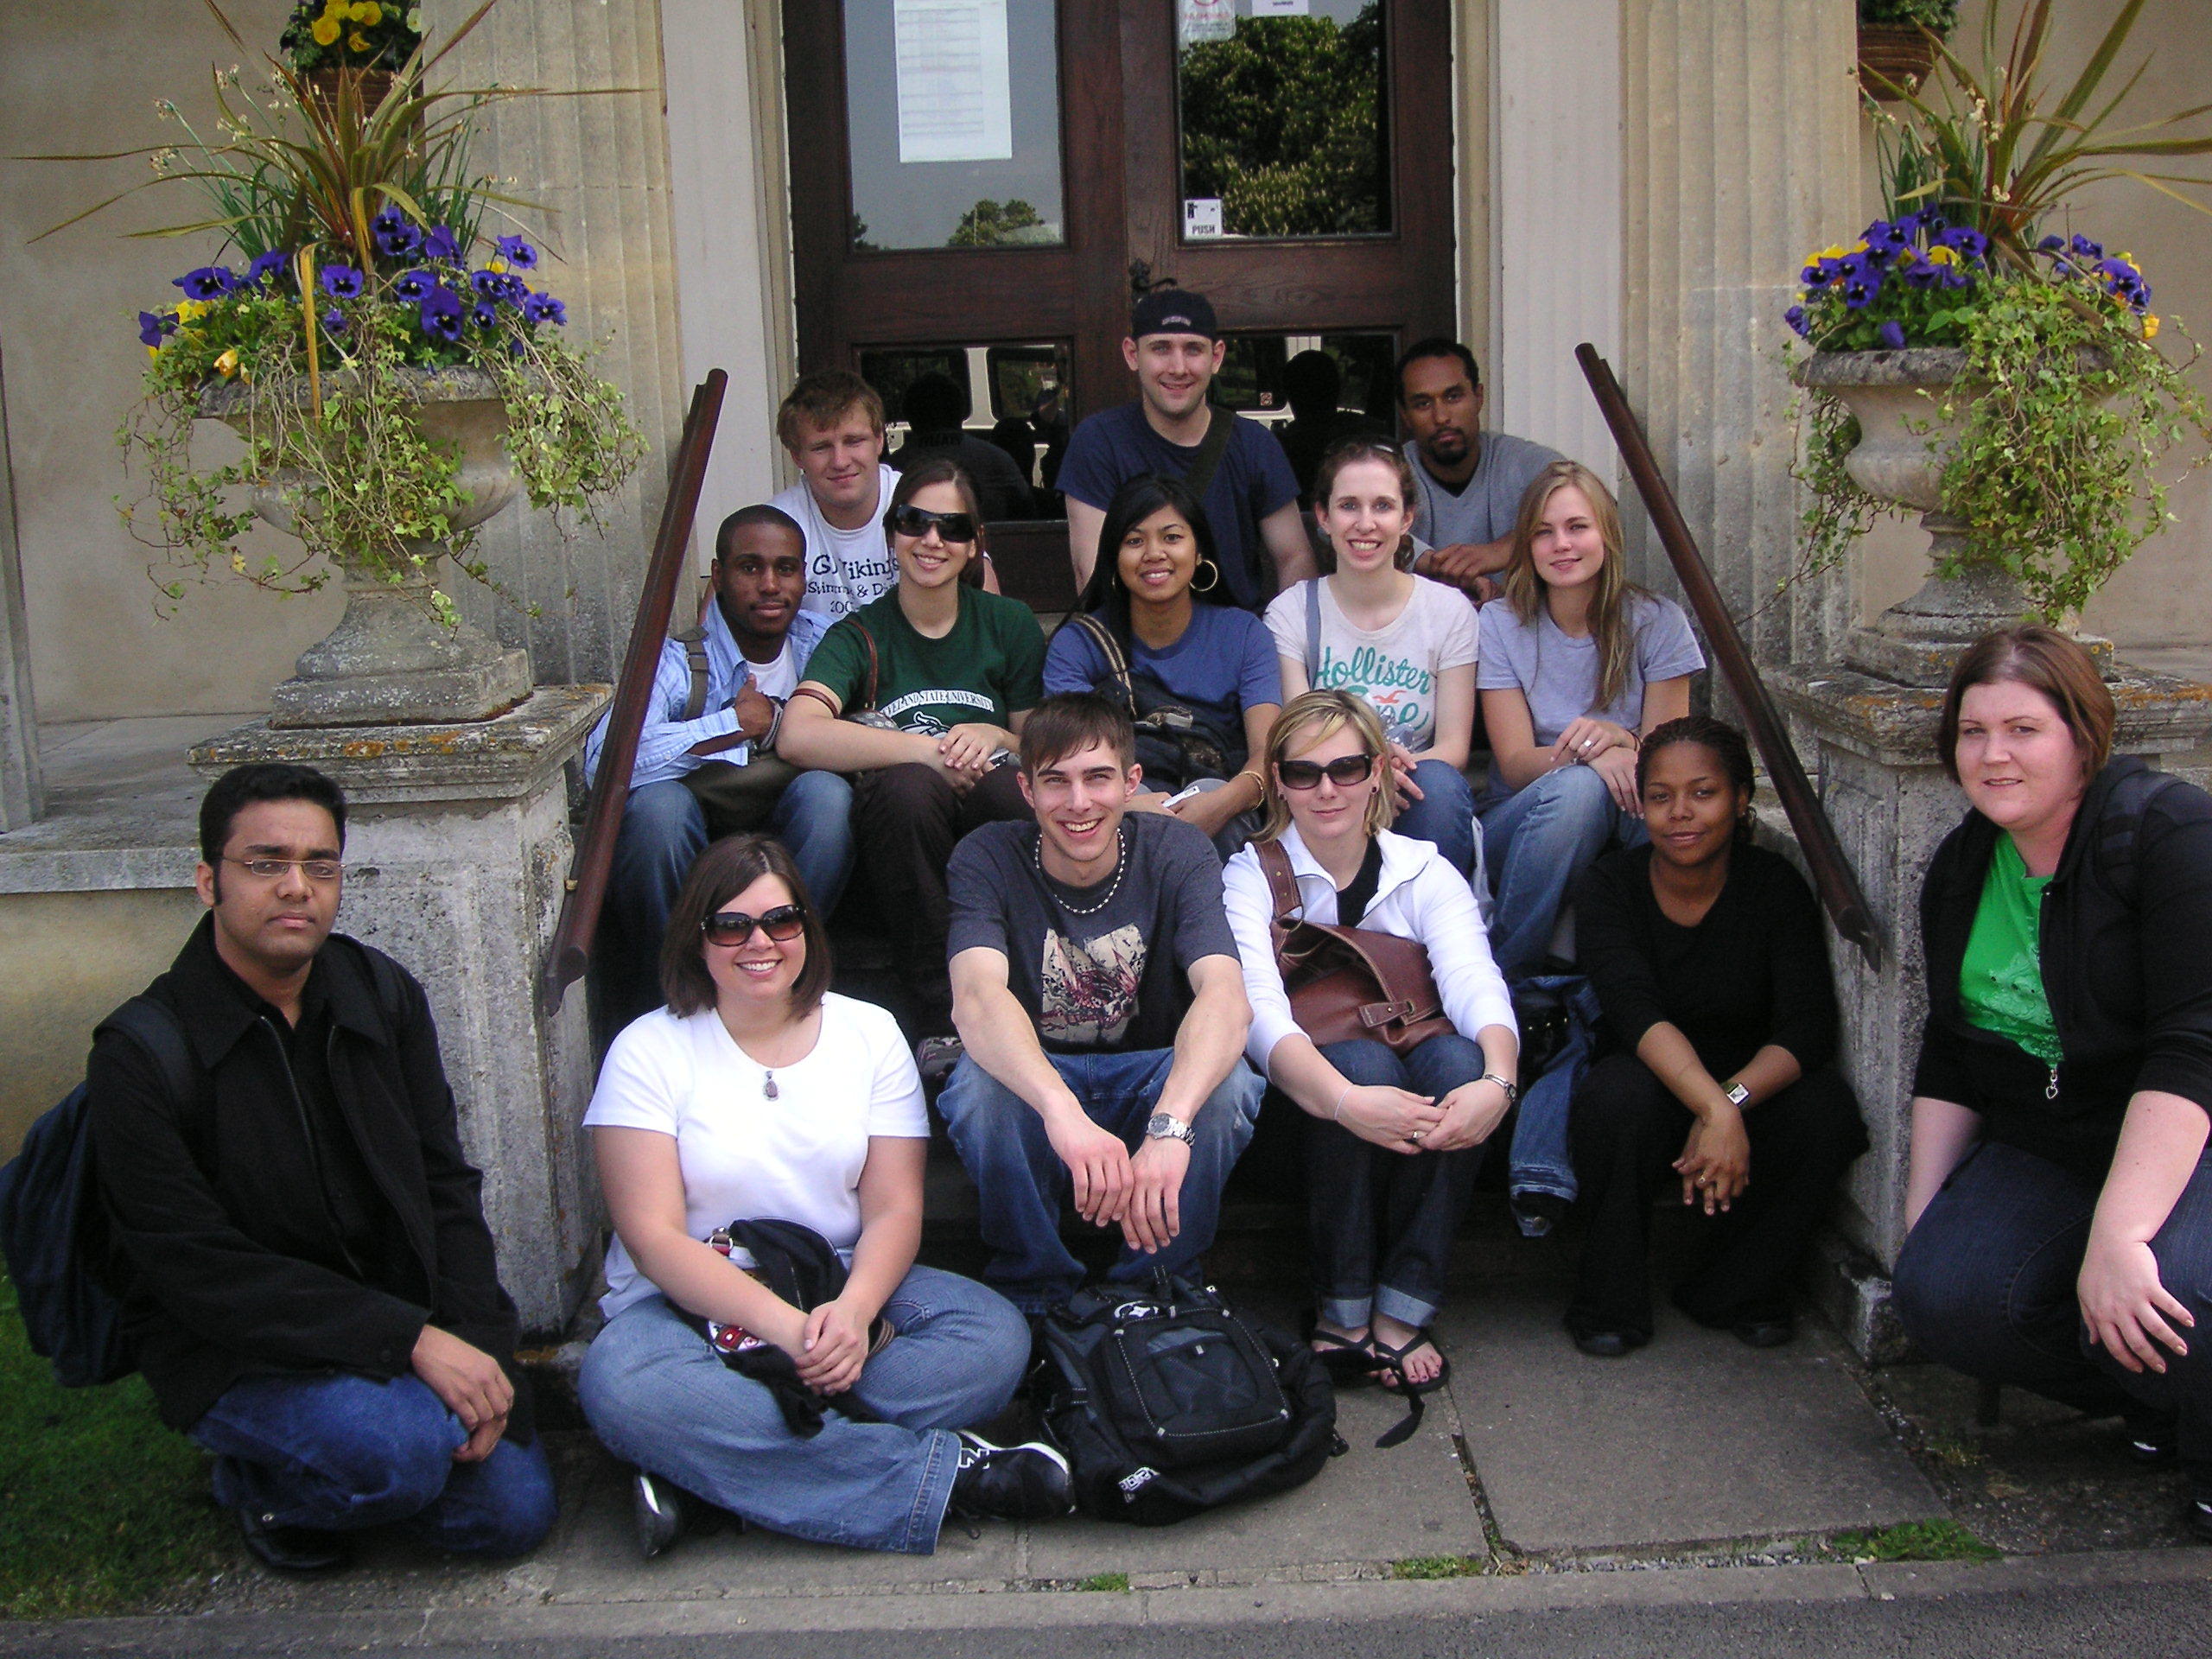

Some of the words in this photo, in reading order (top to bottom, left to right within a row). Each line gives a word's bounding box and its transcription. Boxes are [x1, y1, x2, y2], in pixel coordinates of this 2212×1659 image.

[1192, 225, 1215, 234] PUSH
[856, 584, 869, 598] &
[1312, 645, 1431, 695] Hollister
[919, 690, 947, 706] STATE
[946, 690, 995, 713] UNIVERSITY
